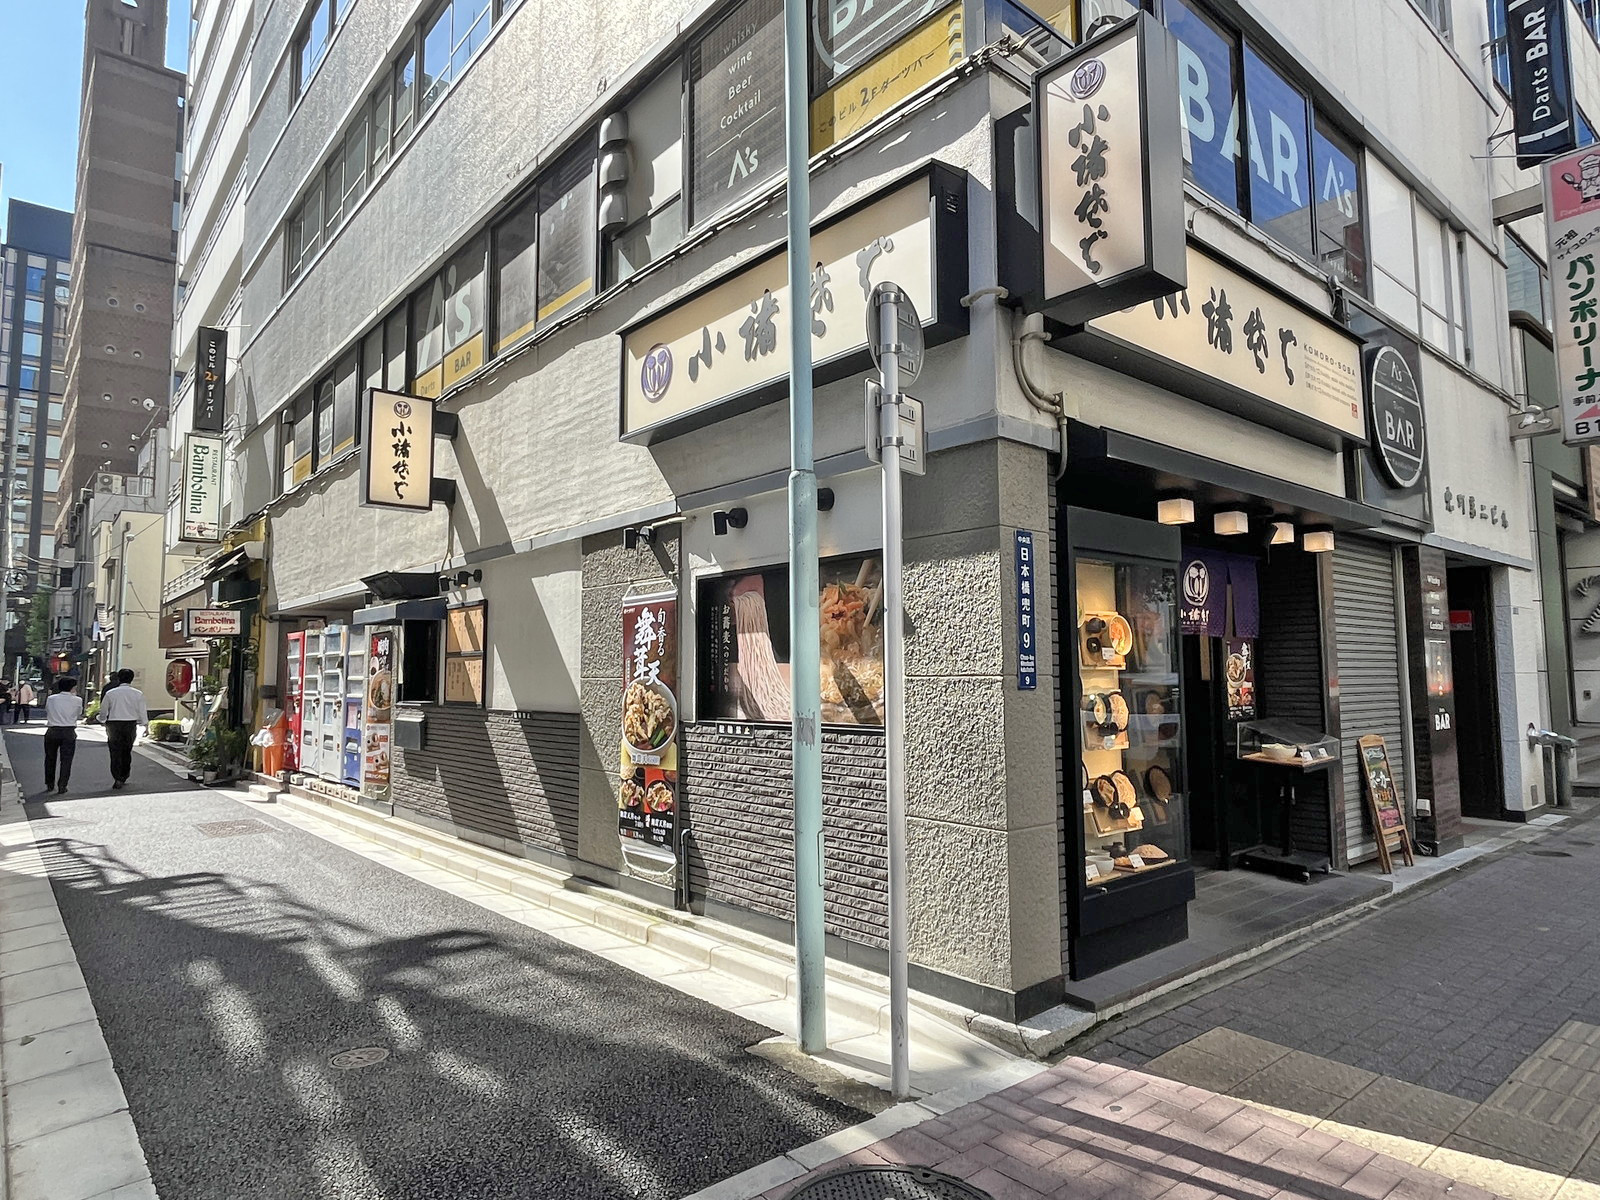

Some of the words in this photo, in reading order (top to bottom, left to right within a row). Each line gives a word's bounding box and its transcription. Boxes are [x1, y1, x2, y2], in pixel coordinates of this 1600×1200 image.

[722, 20, 758, 55] whisky
[1522, 6, 1549, 63] BAR
[728, 50, 753, 75] wine
[728, 74, 753, 100] Beer
[1530, 66, 1551, 122] Darts
[720, 89, 762, 130] Cocktail
[1177, 38, 1303, 209] BAR
[1554, 229, 1579, 249] 元祖
[1566, 253, 1600, 392] バンボリーナ
[453, 350, 472, 374] BAR
[1384, 410, 1416, 450] BAR
[190, 444, 209, 514] Bambolina
[194, 616, 236, 624] Bambolina
[657, 607, 667, 657] 旬香る
[1024, 675, 1031, 685] 9
[1434, 713, 1451, 731] BAR
